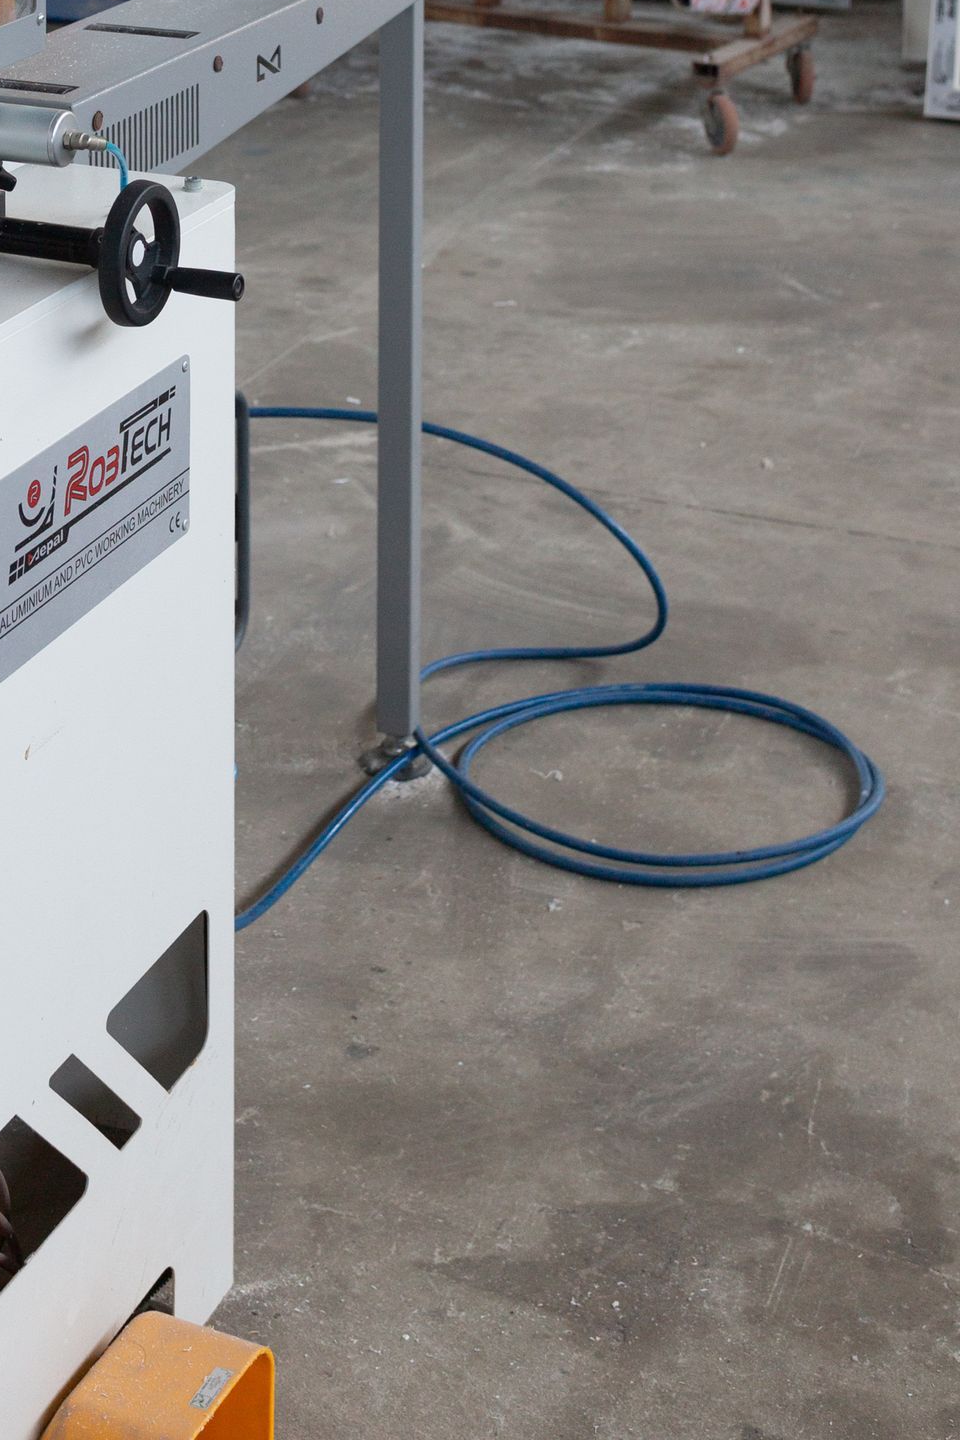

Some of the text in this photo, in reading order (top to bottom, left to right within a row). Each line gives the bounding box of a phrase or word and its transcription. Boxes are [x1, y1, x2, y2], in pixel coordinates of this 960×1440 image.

[0, 479, 184, 634] ALUMINIUM AND PVC WORKING MACHINERY
